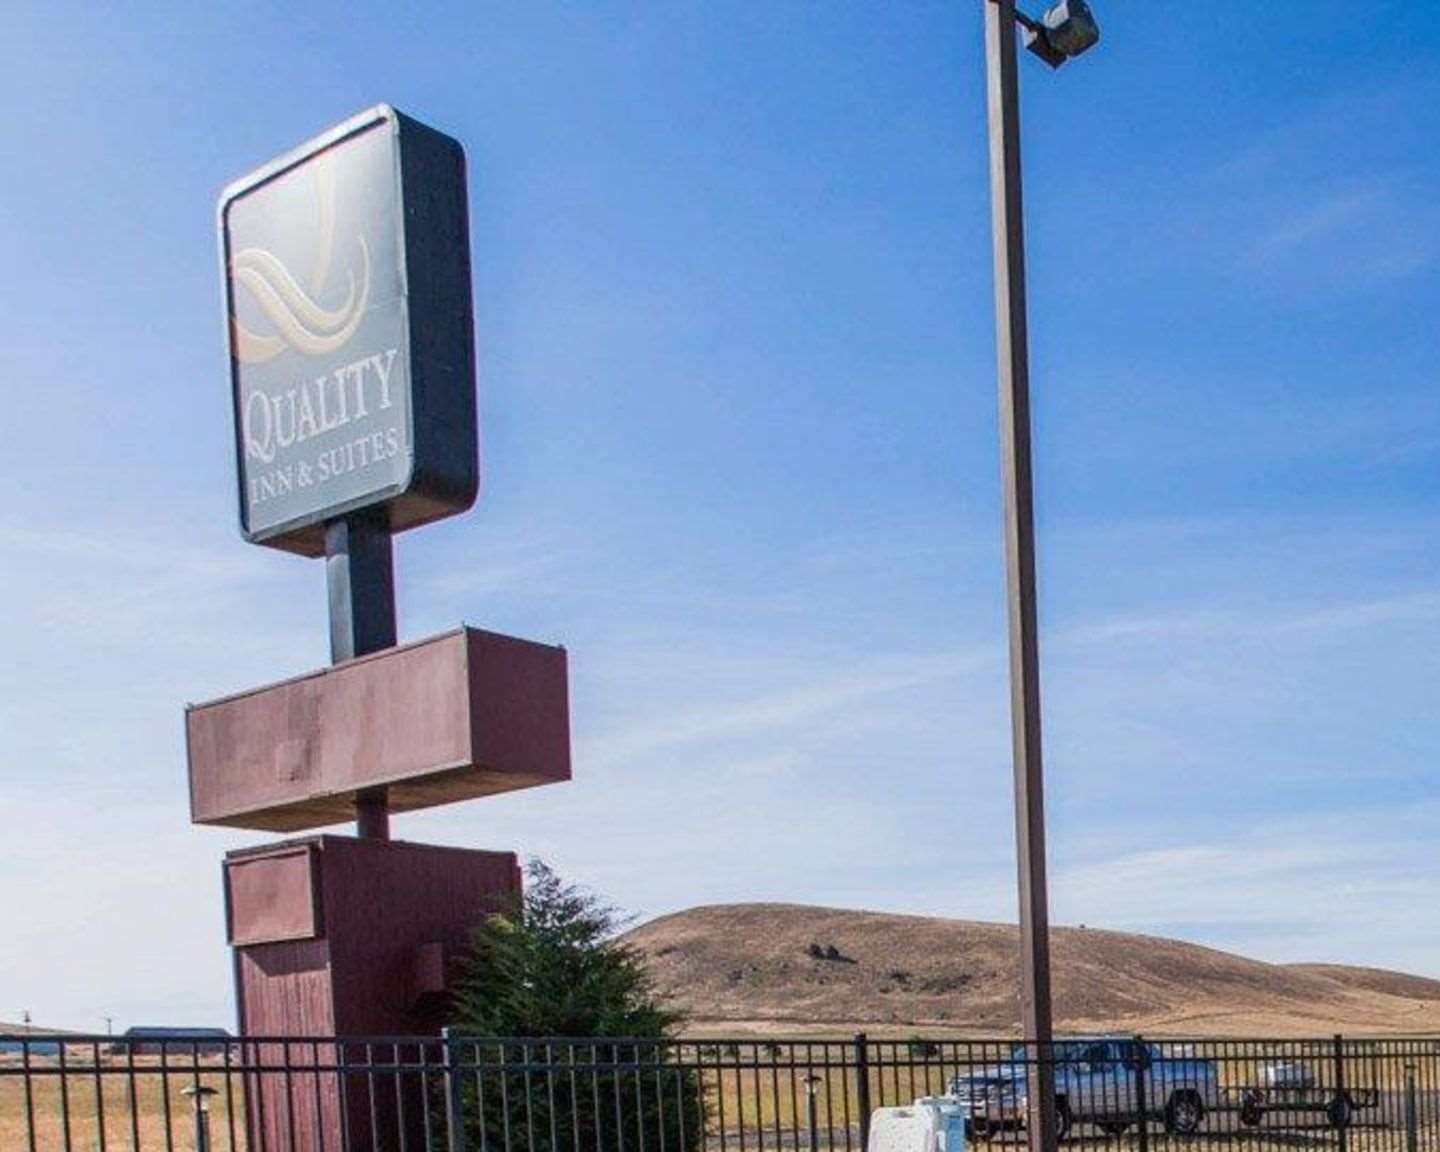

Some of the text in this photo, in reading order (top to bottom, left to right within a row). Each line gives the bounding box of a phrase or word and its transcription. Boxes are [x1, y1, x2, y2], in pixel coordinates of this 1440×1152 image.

[245, 349, 398, 463] QUALITY
[250, 428, 399, 504] INN & SUITES
